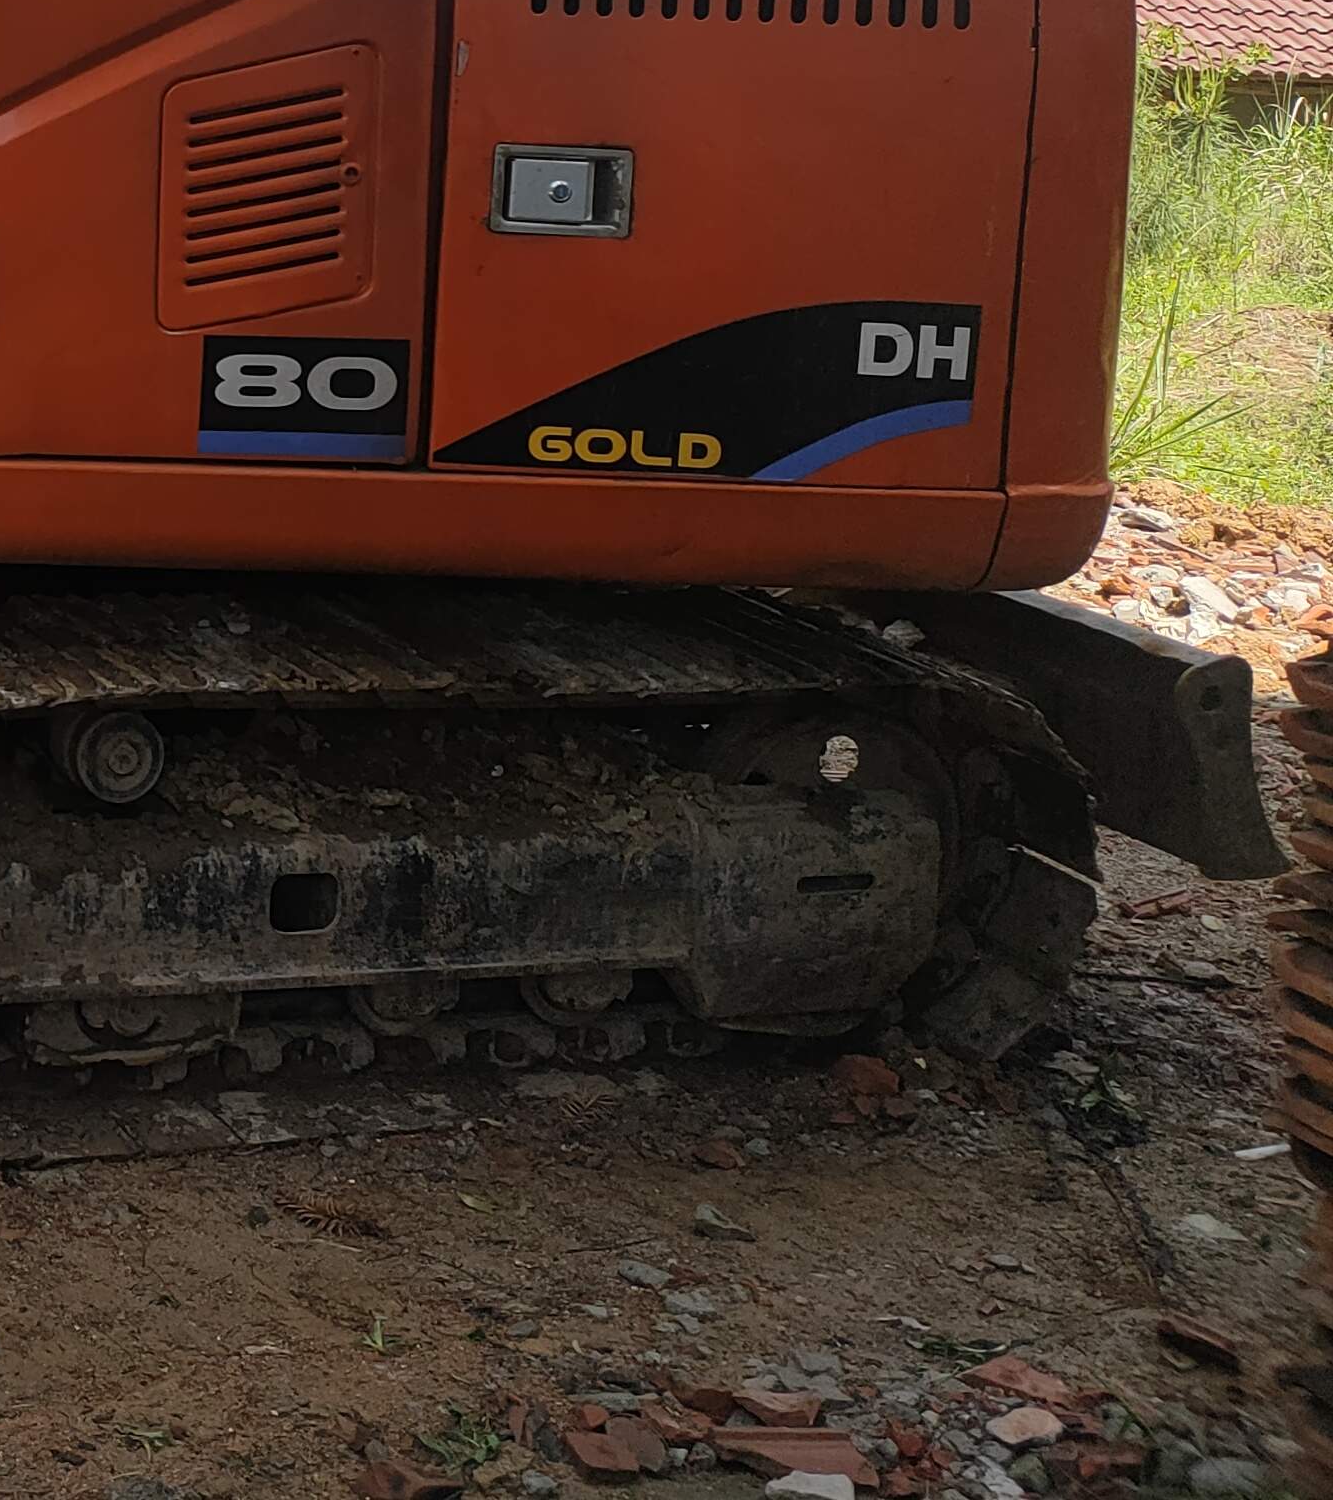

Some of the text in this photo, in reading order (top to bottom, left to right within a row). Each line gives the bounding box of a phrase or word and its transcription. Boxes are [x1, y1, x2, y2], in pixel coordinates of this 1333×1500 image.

[856, 321, 972, 381] DH
[213, 353, 399, 411] 80
[527, 425, 722, 469] GOLD
